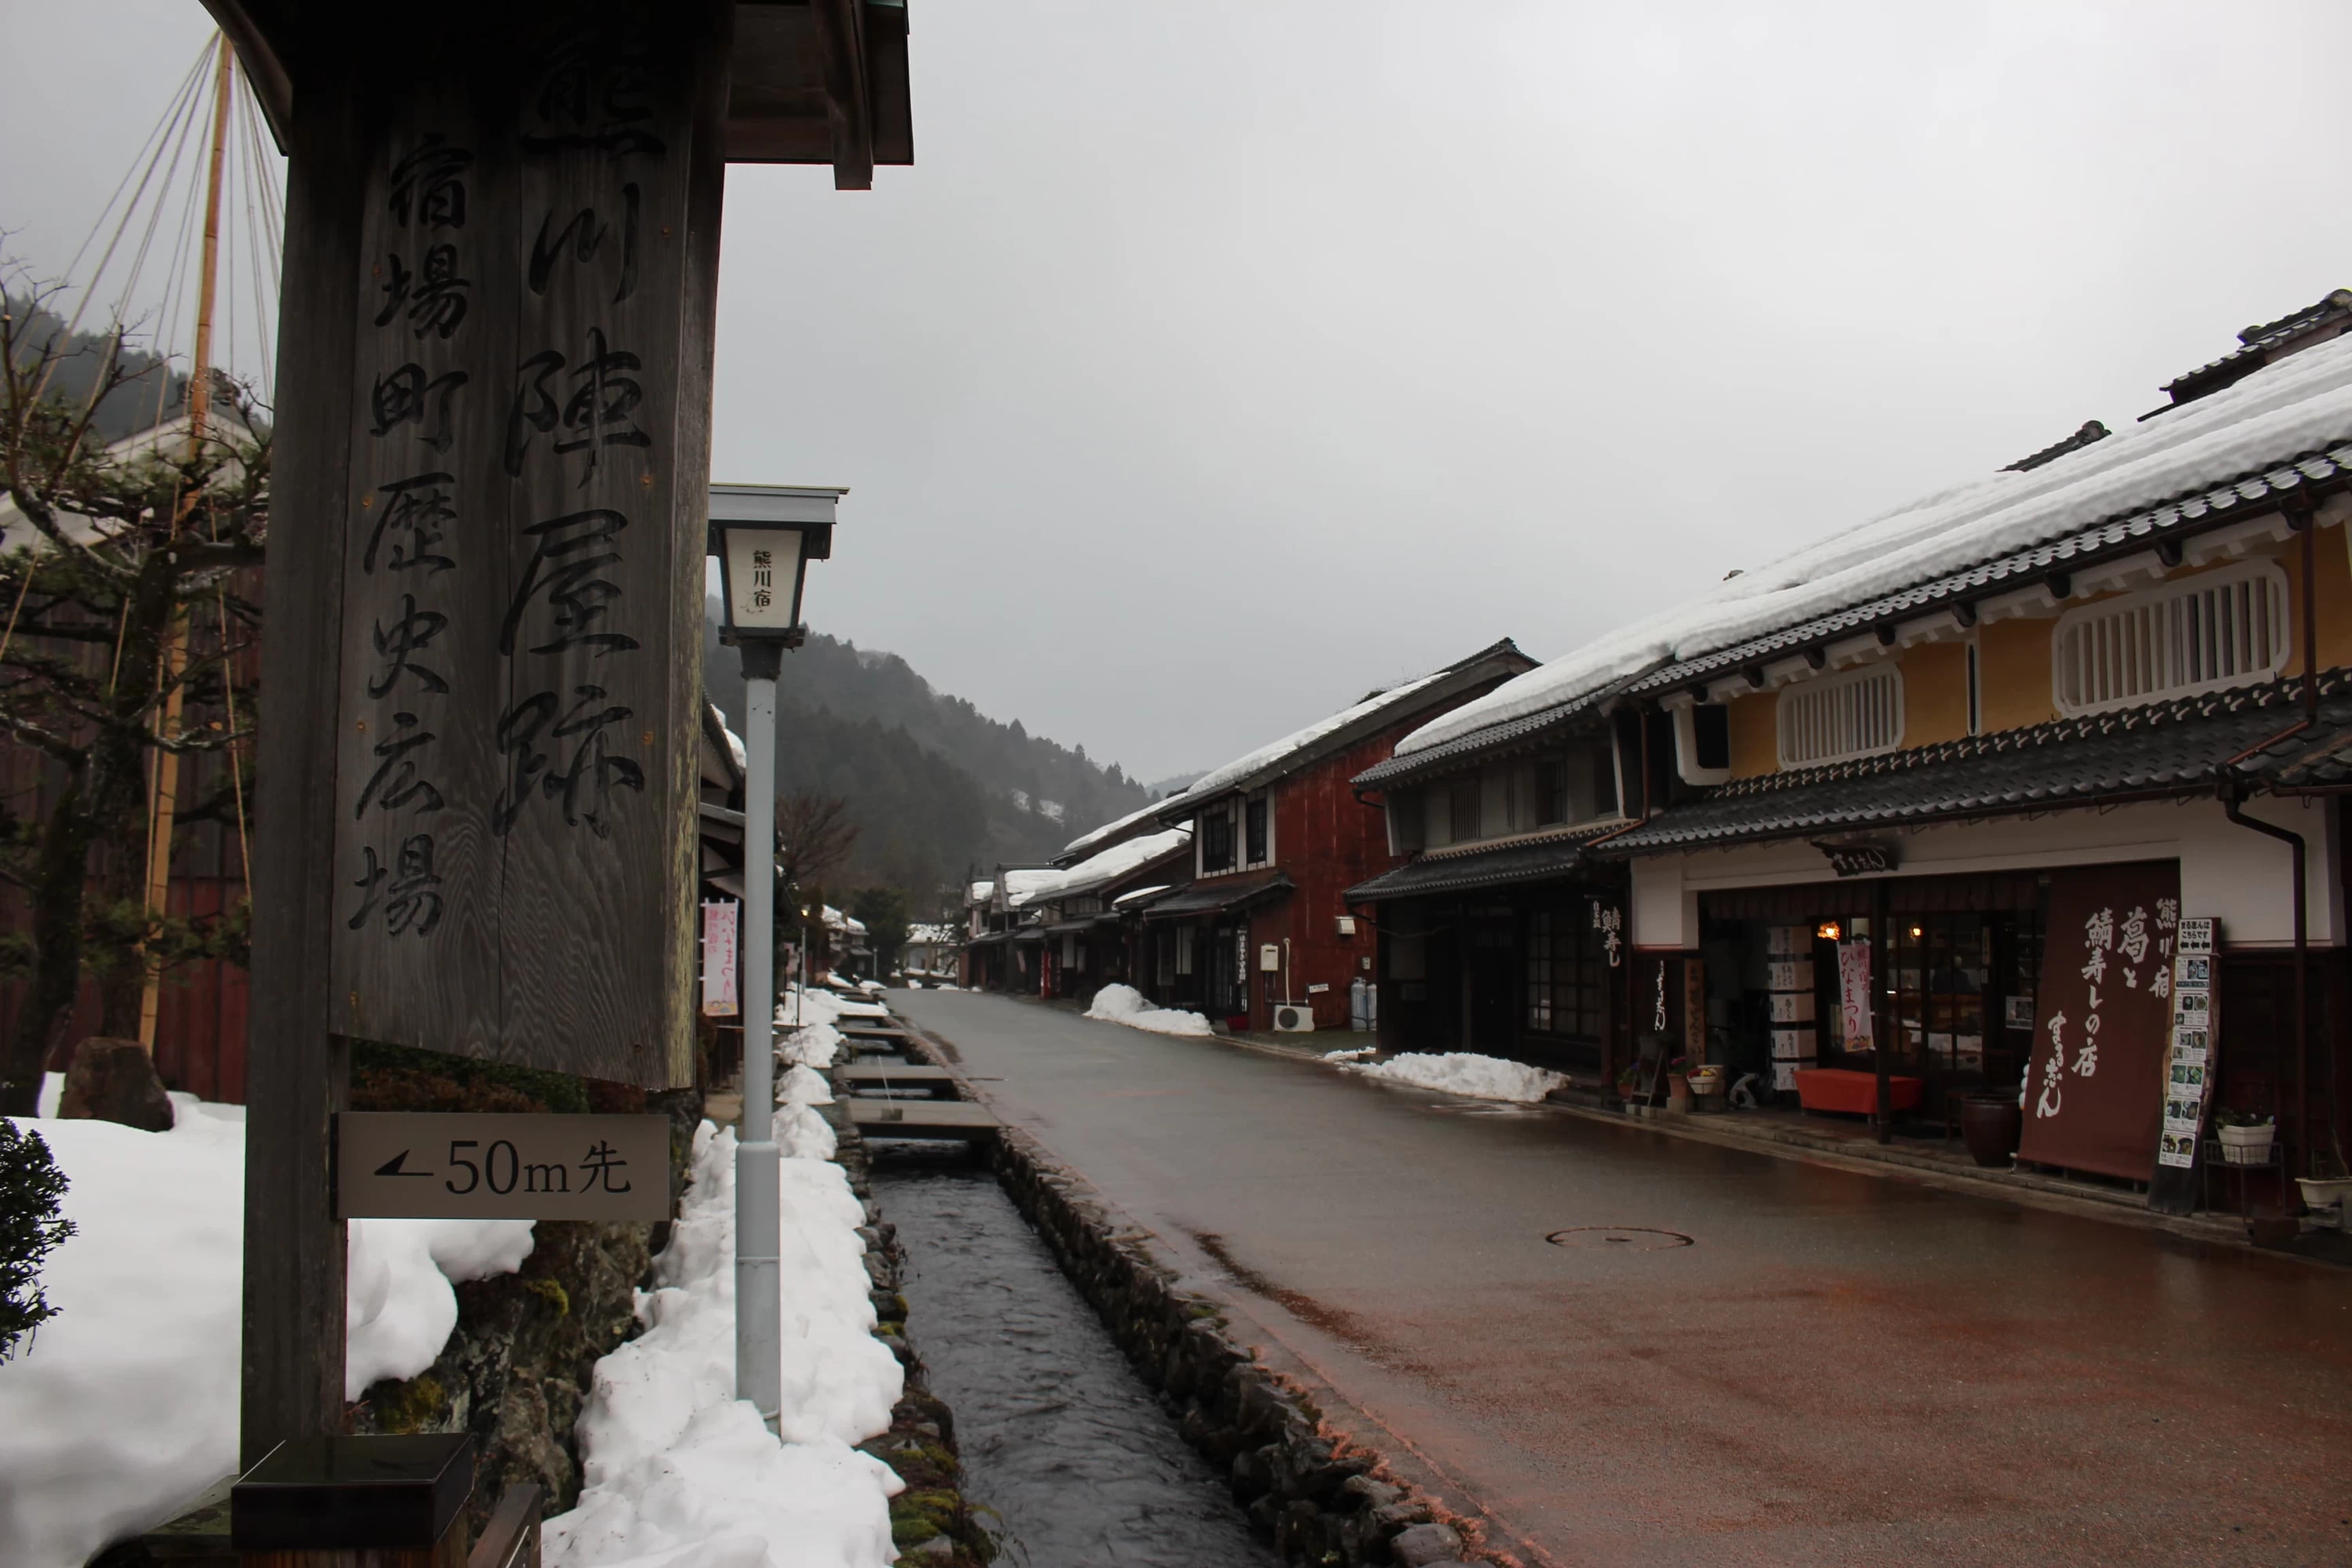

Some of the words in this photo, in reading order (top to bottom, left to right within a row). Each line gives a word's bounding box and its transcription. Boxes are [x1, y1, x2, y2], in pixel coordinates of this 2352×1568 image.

[492, 6, 666, 840] 熊川陣屋跡
[349, 132, 474, 936] 宿場町歴史広場
[753, 550, 771, 606] 熊川宿
[1601, 906, 1622, 967] 鯖寿し
[2117, 906, 2149, 989] 葛と
[2149, 898, 2177, 999] 熊川宿
[1841, 950, 1859, 1033] ひなまつり
[2071, 906, 2114, 1077] 鯖寿しの店
[2037, 1010, 2067, 1119] まる志ん
[445, 1139, 631, 1195] 50m先
